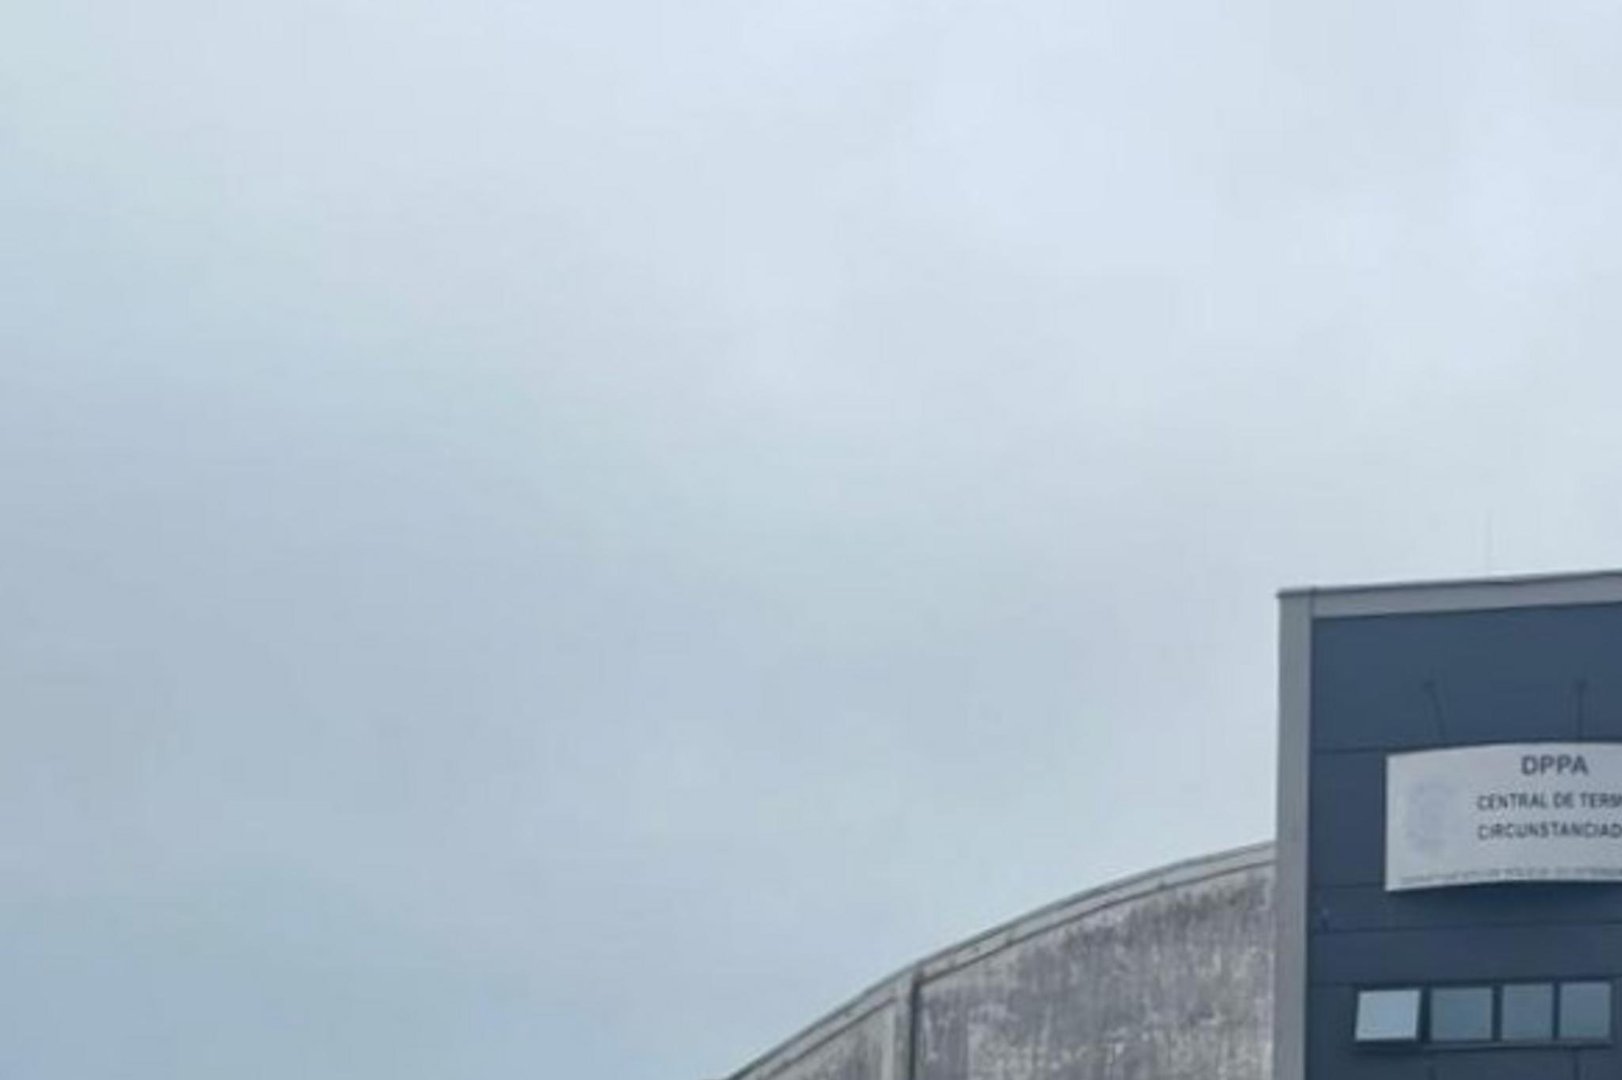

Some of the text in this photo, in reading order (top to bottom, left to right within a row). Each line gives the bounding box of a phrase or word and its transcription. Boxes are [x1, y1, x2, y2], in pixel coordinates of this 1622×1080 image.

[1521, 754, 1589, 775] DPPA
[1475, 794, 1548, 812] CENTRAL
[1553, 792, 1576, 809] DE
